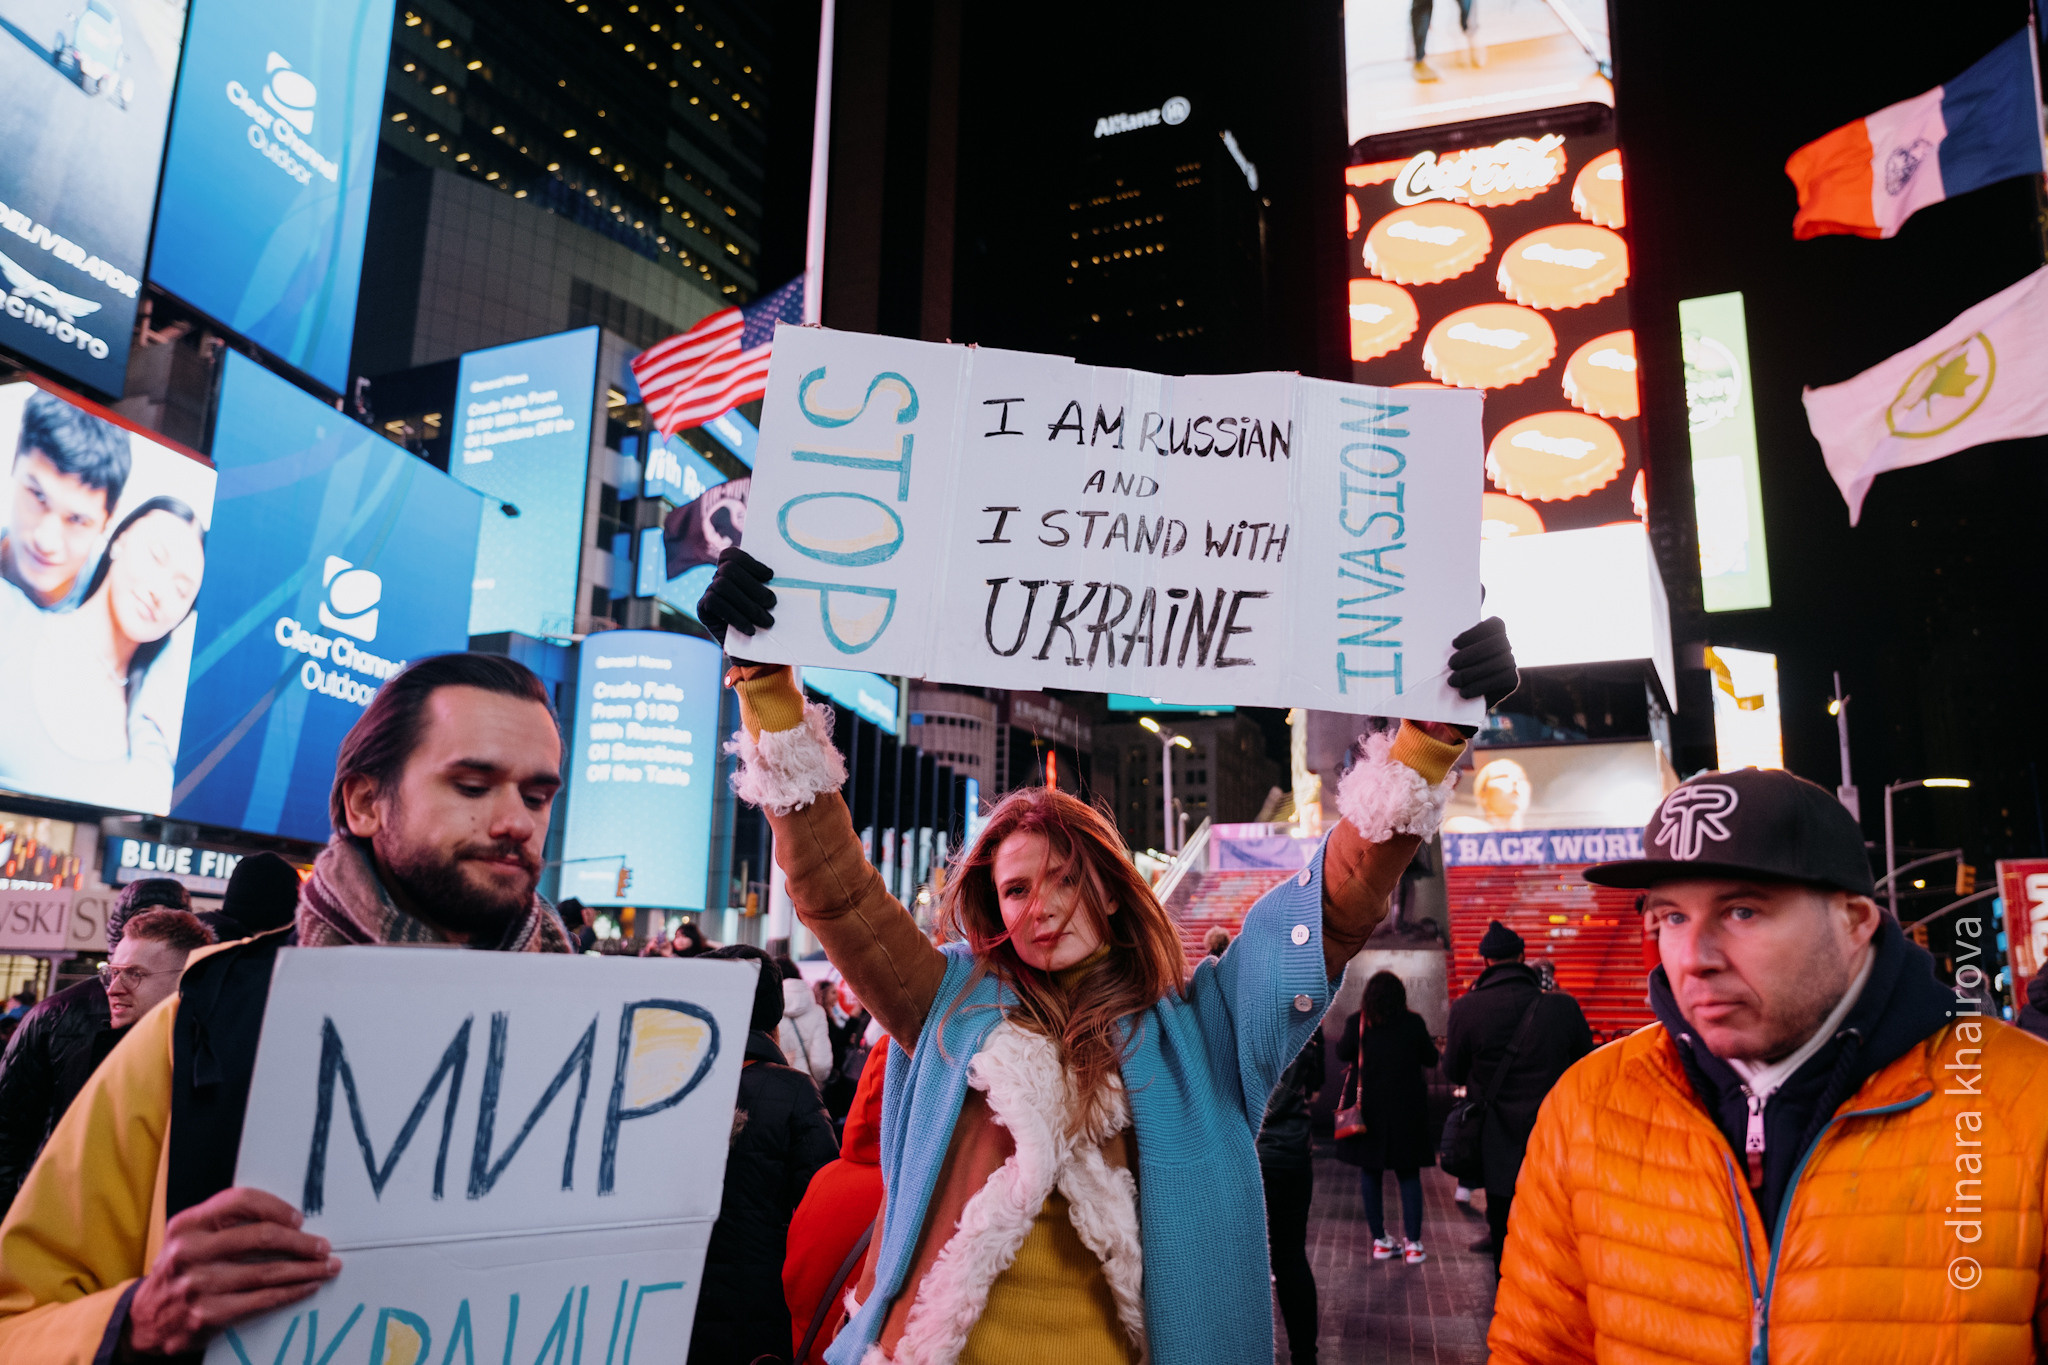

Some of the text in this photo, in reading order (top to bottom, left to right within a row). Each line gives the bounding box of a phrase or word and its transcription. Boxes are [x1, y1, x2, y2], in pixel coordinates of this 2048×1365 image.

[983, 398, 1025, 437] I
[1048, 400, 1124, 449] AM
[1083, 470, 1159, 497] AND
[767, 366, 919, 654] STOP
[977, 506, 1021, 543] I
[1038, 509, 1187, 559] STAND
[1336, 397, 1410, 695] INVASION
[120, 838, 193, 875] BLUE
[1458, 836, 1545, 863] BACK
[1550, 833, 1647, 861] WORL
[302, 998, 721, 1217] МИР
